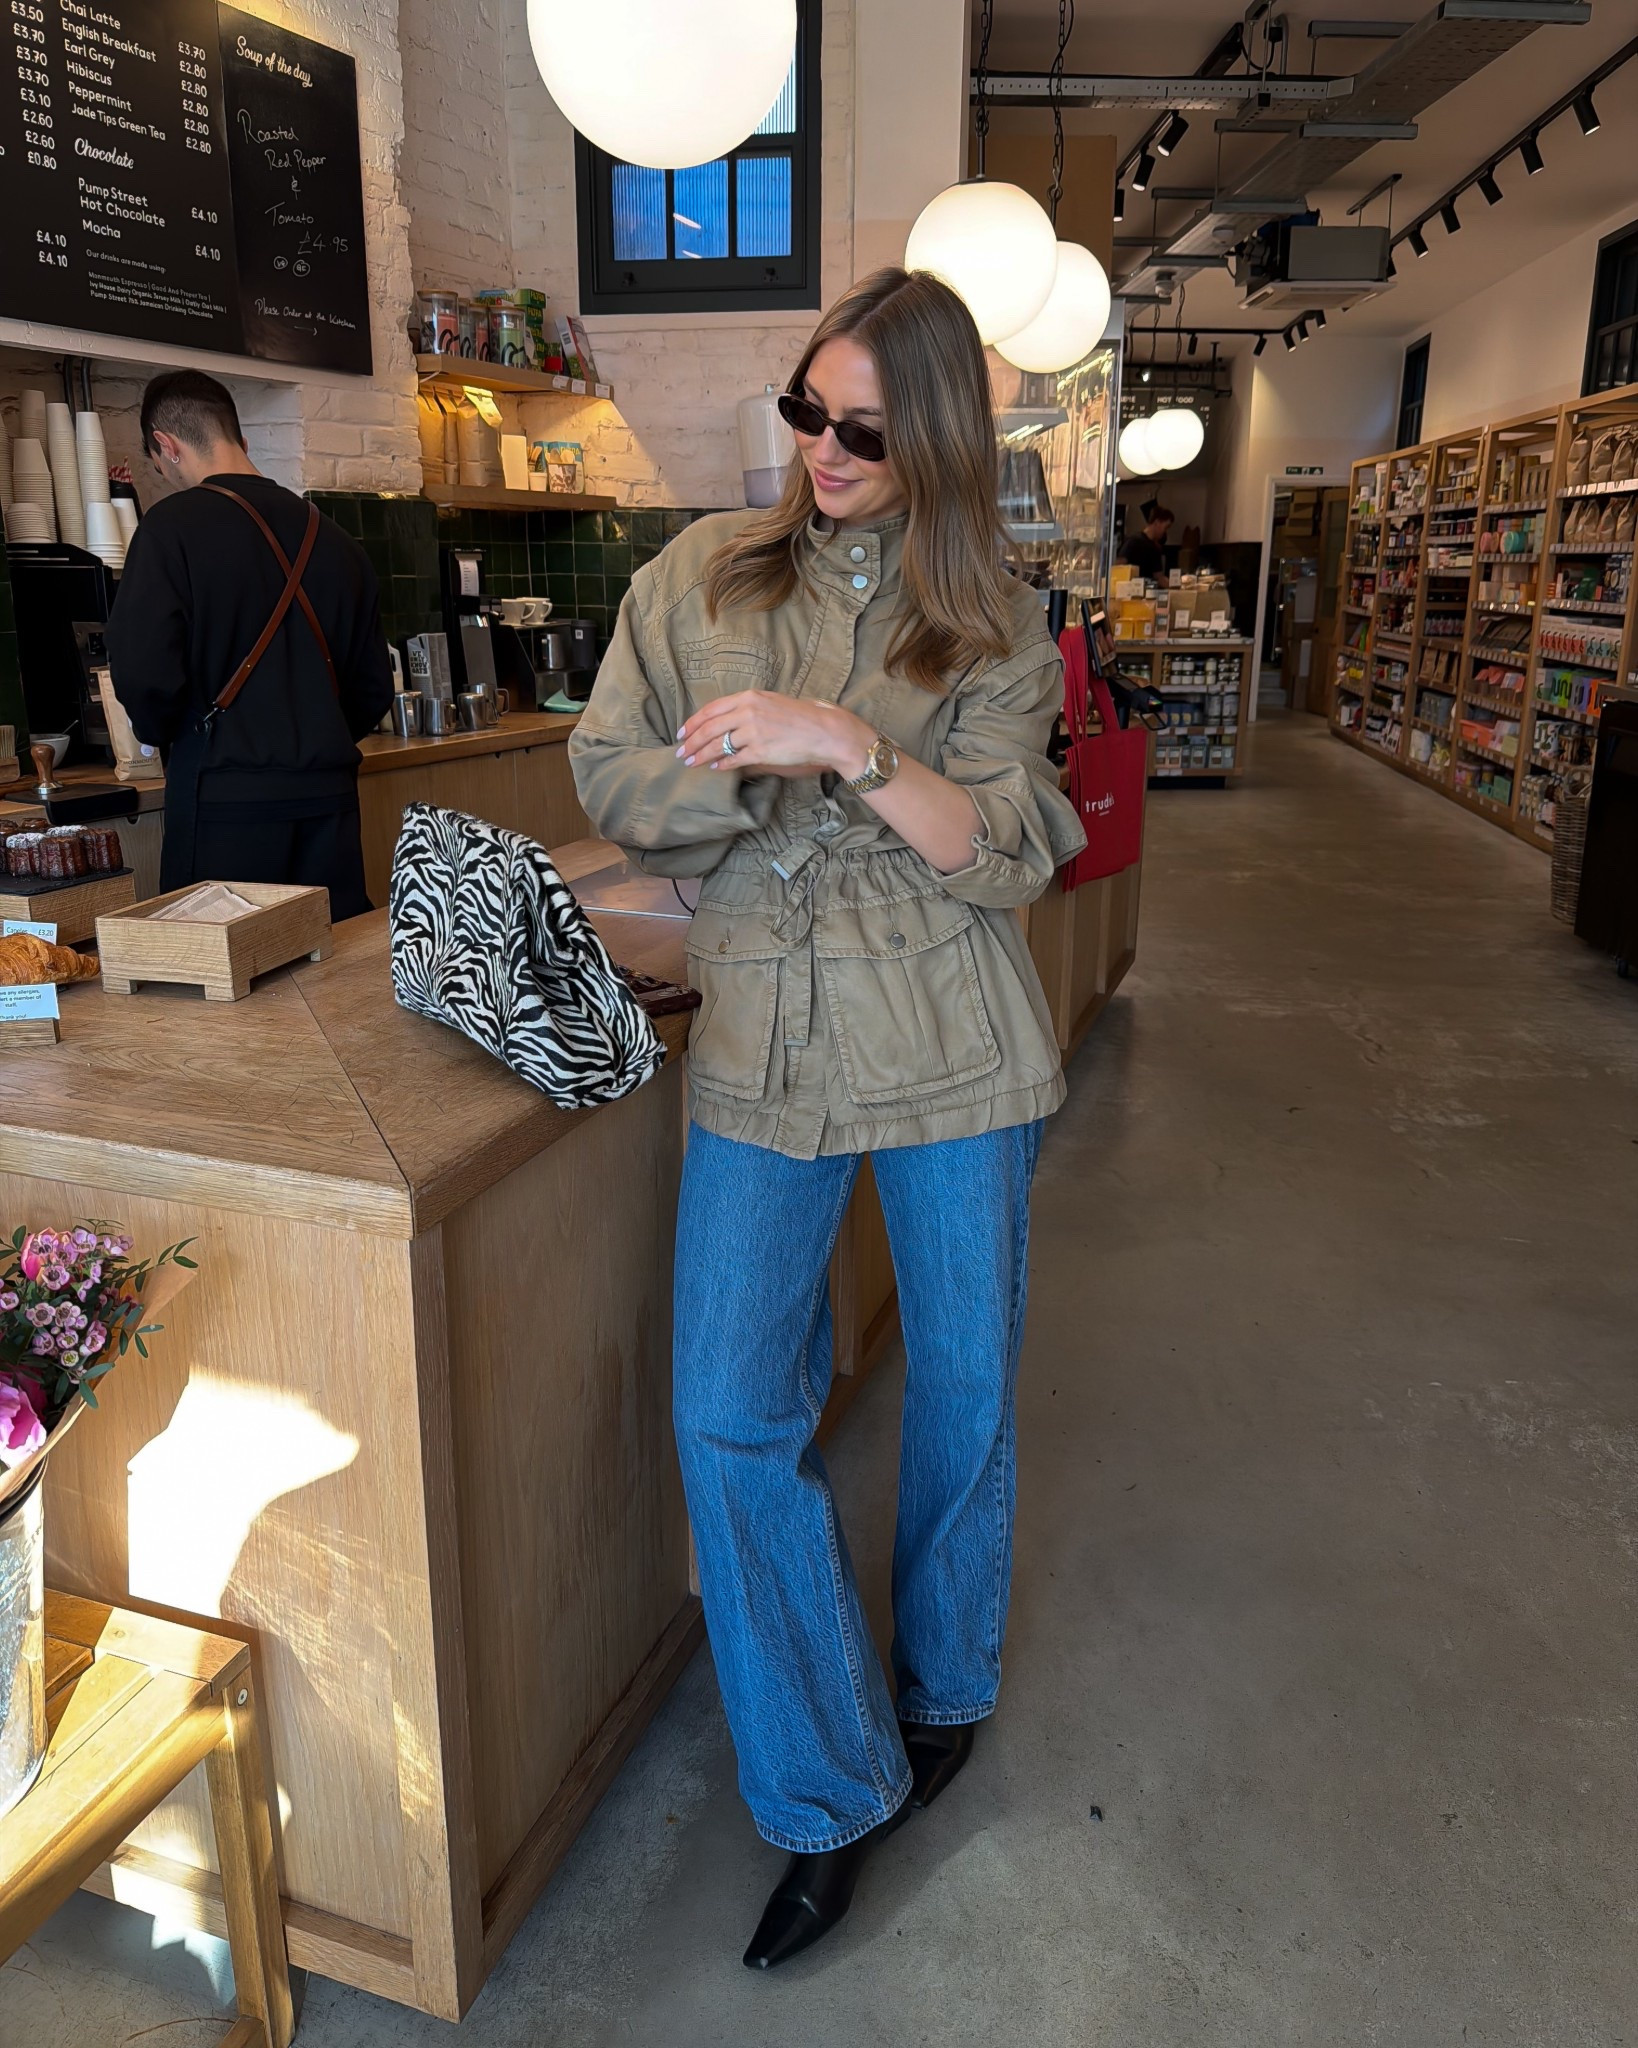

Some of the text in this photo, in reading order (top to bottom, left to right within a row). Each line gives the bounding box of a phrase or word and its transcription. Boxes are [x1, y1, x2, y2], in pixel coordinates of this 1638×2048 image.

[11, 1, 44, 23] £3.50
[60, 0, 121, 30] Chai Latte
[13, 22, 45, 44] £3.70
[61, 17, 157, 63] English Breakfast
[16, 45, 48, 67] £3.70
[64, 39, 116, 69] Earl Grey
[178, 41, 206, 61] £3.70
[236, 36, 313, 87] Soup of the day
[18, 66, 49, 87] £3.70
[66, 60, 113, 86] Hibiscus
[179, 60, 207, 79] £2.80
[20, 87, 51, 108] £3.10
[68, 81, 132, 112] Peppermint
[181, 79, 208, 98] £2.80
[182, 98, 209, 117] £2.80
[22, 109, 53, 129] £2.60
[71, 103, 166, 141] Jade Tips Green Tea
[184, 118, 210, 136] £2.80
[237, 109, 300, 144] Roasted
[25, 130, 55, 150] £2.60
[185, 136, 212, 154] £2.80
[27, 151, 57, 170] £0.80
[74, 137, 135, 169] Chocolate
[264, 149, 327, 175] Red Pepper
[78, 177, 148, 207] Pump Street
[80, 196, 166, 227] Hot Chocolate
[191, 207, 218, 224] £4.10
[264, 201, 314, 227] Tomato
[36, 230, 67, 248] £4.10
[82, 219, 121, 239] Mocha
[195, 244, 221, 261] £4.10
[297, 231, 349, 254] £4.95
[38, 250, 68, 268] £4.10
[86, 249, 100, 258] Our
[100, 252, 120, 263] drinks
[121, 258, 131, 266] are
[132, 260, 148, 269] made
[121, 278, 147, 289] Espresso
[108, 293, 127, 303] Street
[165, 303, 187, 315] Drinking
[255, 297, 280, 316] Please
[283, 306, 302, 318] Order
[329, 314, 356, 330] Kitchen
[38, 929, 54, 937] £3.20
